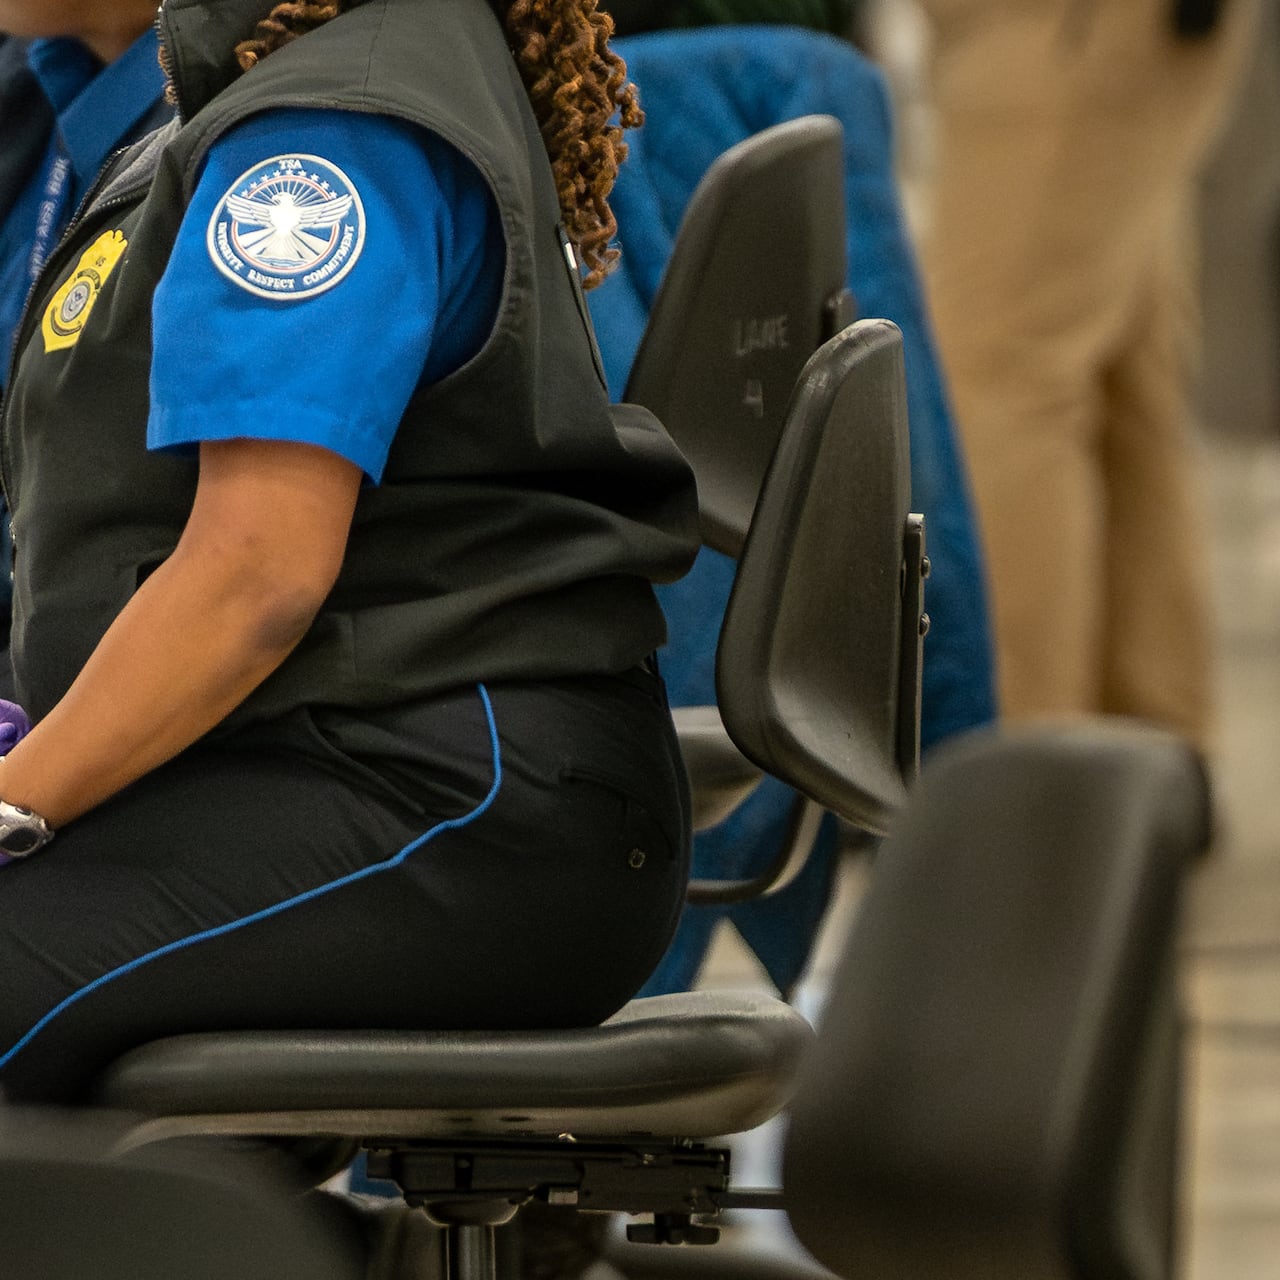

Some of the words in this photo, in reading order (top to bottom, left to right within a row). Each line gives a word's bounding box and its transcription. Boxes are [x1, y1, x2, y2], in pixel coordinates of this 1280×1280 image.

[278, 159, 303, 170] TSA
[217, 221, 244, 270] INTEGRITY
[247, 269, 295, 289] RESPECT
[302, 224, 355, 286] COMMITMENT
